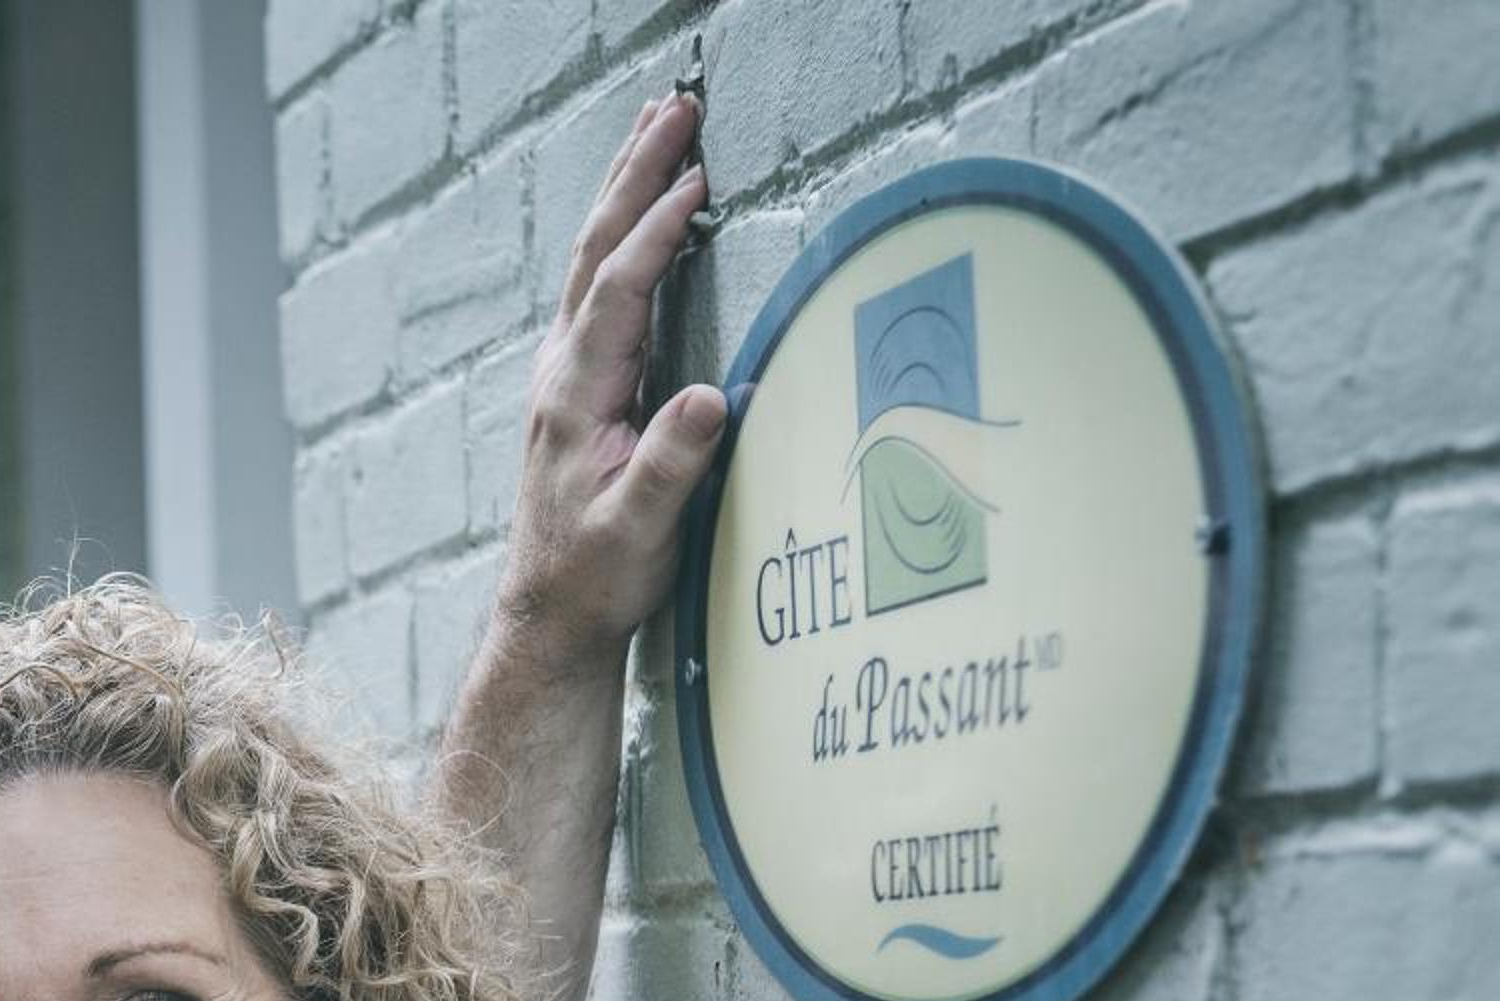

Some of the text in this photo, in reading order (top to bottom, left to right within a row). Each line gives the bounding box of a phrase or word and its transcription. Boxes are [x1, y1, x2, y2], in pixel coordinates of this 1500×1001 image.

[756, 527, 852, 647] GÎTE
[812, 673, 849, 764] du
[855, 634, 1032, 753] Passant
[870, 802, 1003, 904] CERTIFIÉ
